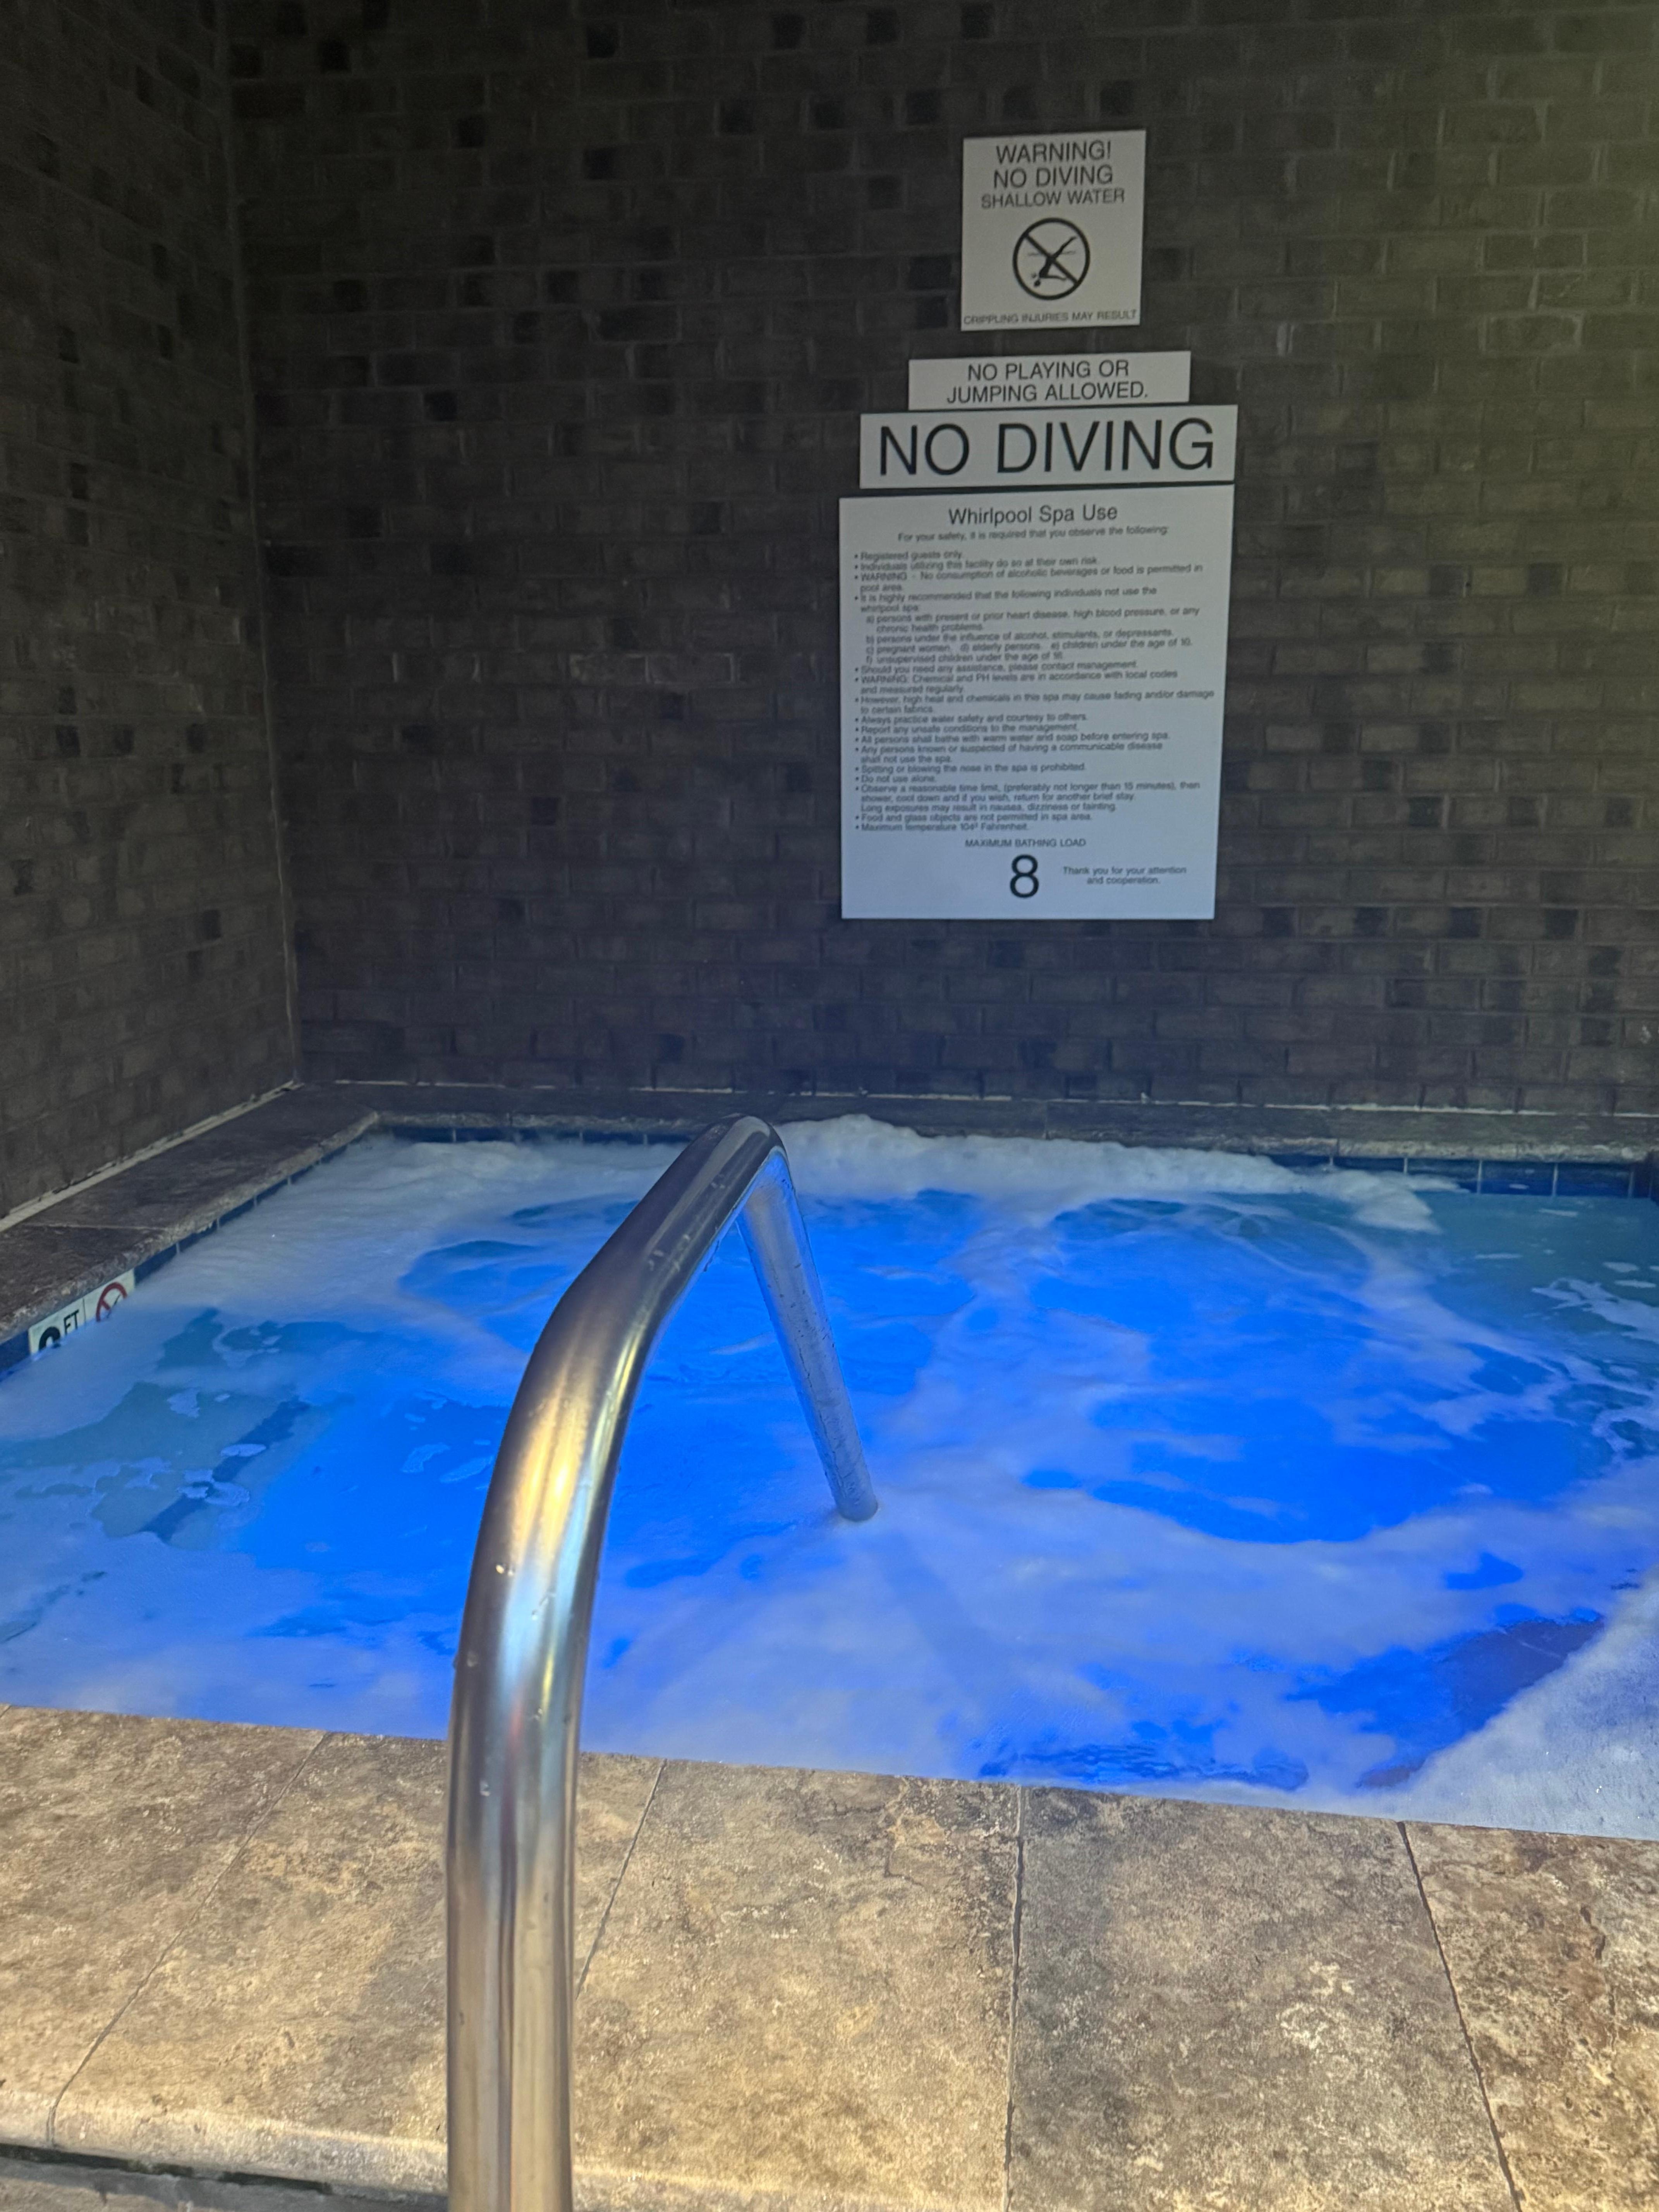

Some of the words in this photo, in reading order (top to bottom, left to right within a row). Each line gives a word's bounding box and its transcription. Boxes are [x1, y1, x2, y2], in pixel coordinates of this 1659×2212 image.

[996, 140, 1111, 163] WARNING!
[994, 168, 1027, 188] NO
[1036, 164, 1113, 186] DIVING
[981, 191, 1061, 208] SHALLOW
[1067, 188, 1124, 204] WATER
[1022, 313, 1068, 322] INJURIES
[1072, 312, 1093, 320] MAY
[1097, 309, 1136, 320] RESULT
[968, 364, 997, 381] NO
[1006, 361, 1090, 380] PLAYING
[1099, 360, 1128, 377] OR
[947, 384, 1037, 404] JUMPING
[1045, 381, 1147, 400] ALLOWED.
[880, 424, 969, 476] NO
[998, 418, 1213, 473] DIVING
[948, 506, 1031, 528] Whirlpool
[1039, 505, 1074, 525] Spa
[1083, 503, 1117, 521] Use
[898, 533, 913, 541] For
[989, 530, 1026, 540] required
[1029, 529, 1046, 538] that
[1049, 530, 1066, 538] you
[1068, 527, 1106, 536] observe
[1109, 526, 1123, 535] the
[965, 839, 1012, 847] MAXIMUM
[1015, 838, 1057, 847] BATHING
[1060, 838, 1086, 847] LOAD
[1010, 854, 1039, 898] 8
[1061, 866, 1090, 874] Thank
[1087, 876, 1104, 884] and
[64, 1309, 79, 1336] FT
